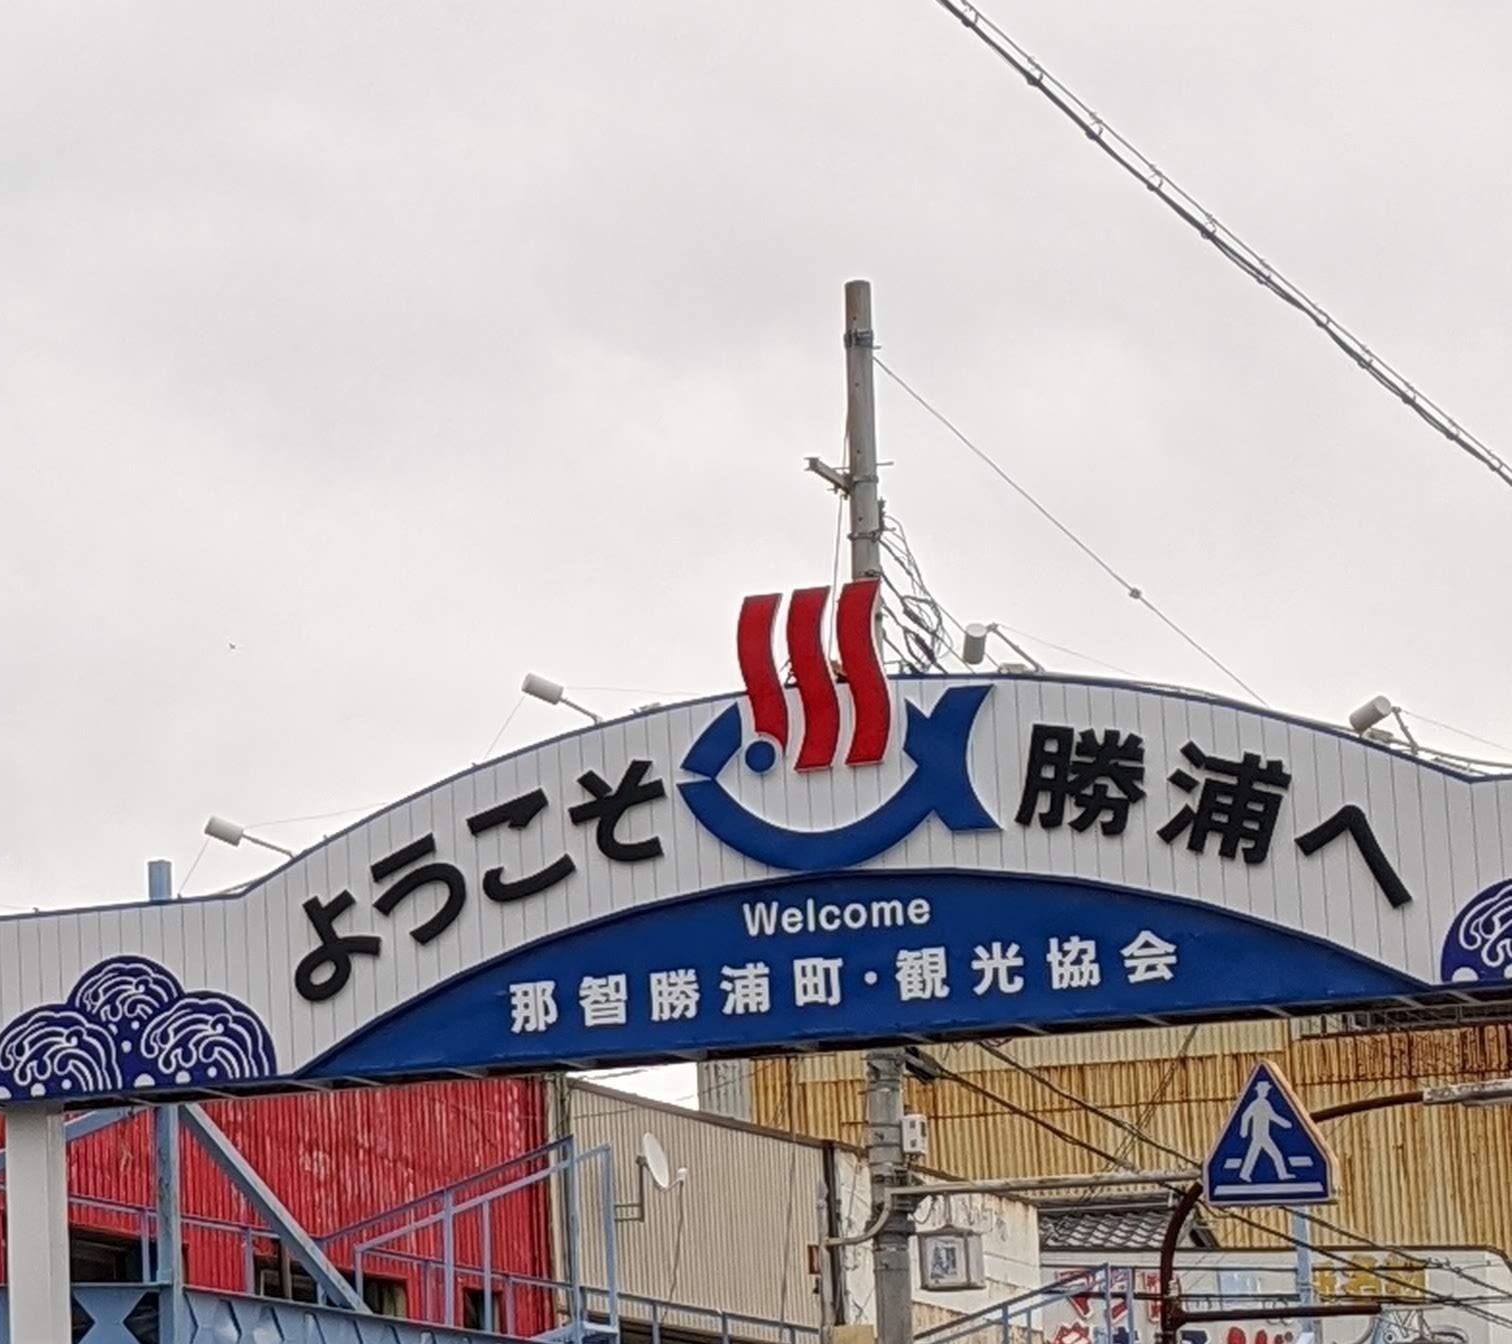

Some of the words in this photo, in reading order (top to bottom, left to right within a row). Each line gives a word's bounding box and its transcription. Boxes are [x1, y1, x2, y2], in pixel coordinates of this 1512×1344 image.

[291, 759, 665, 1000] ようこそ
[1015, 723, 1410, 909] 勝浦へ
[742, 891, 931, 938] Welcome
[509, 929, 1178, 1034] 那智勝浦町・観光協会
